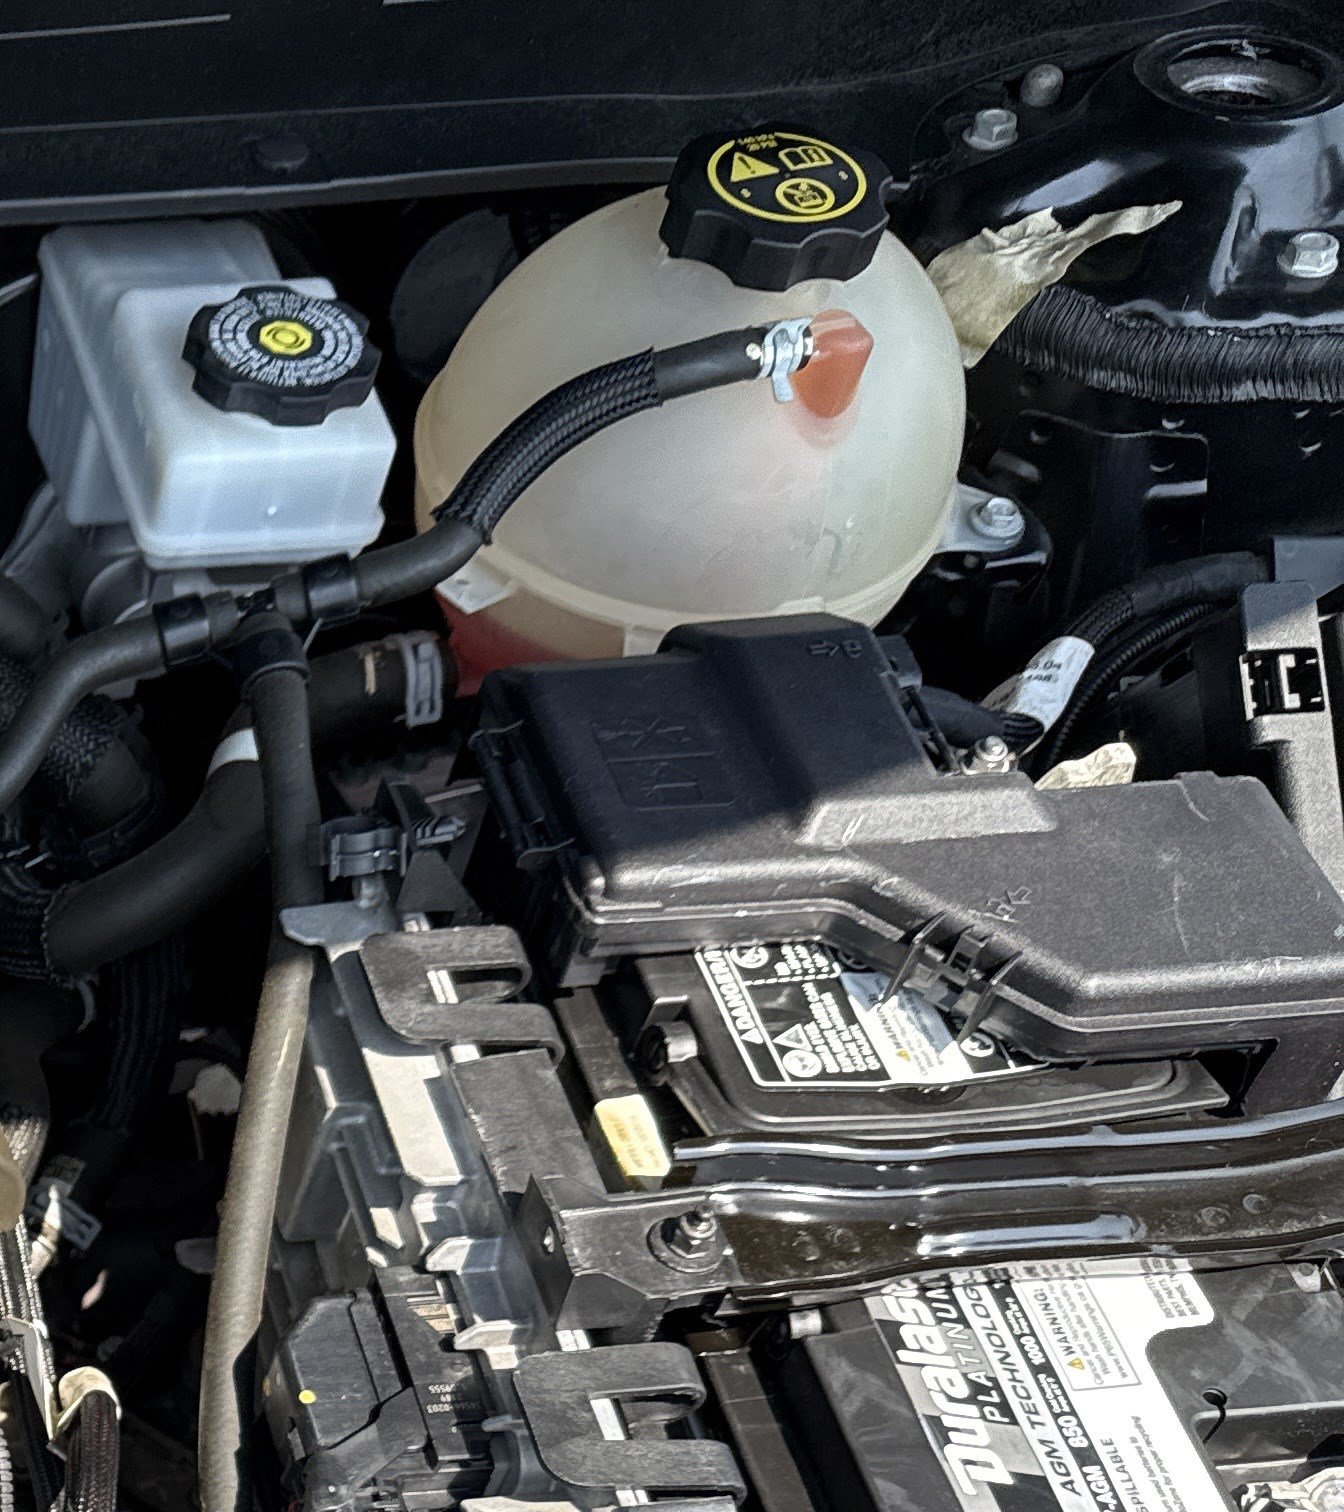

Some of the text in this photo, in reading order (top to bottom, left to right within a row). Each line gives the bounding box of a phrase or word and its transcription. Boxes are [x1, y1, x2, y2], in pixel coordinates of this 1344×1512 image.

[1030, 1287, 1076, 1356] WARNING:
[1018, 1335, 1046, 1365] 1000
[1056, 1416, 1088, 1448] 850
[1129, 1415, 1152, 1447] recycling
[1037, 1439, 1081, 1496] AGM
[1131, 1445, 1156, 1477] batteries
[1148, 1449, 1169, 1473] proper
[1149, 1478, 1166, 1497] used
[1161, 1476, 1172, 1485] for
